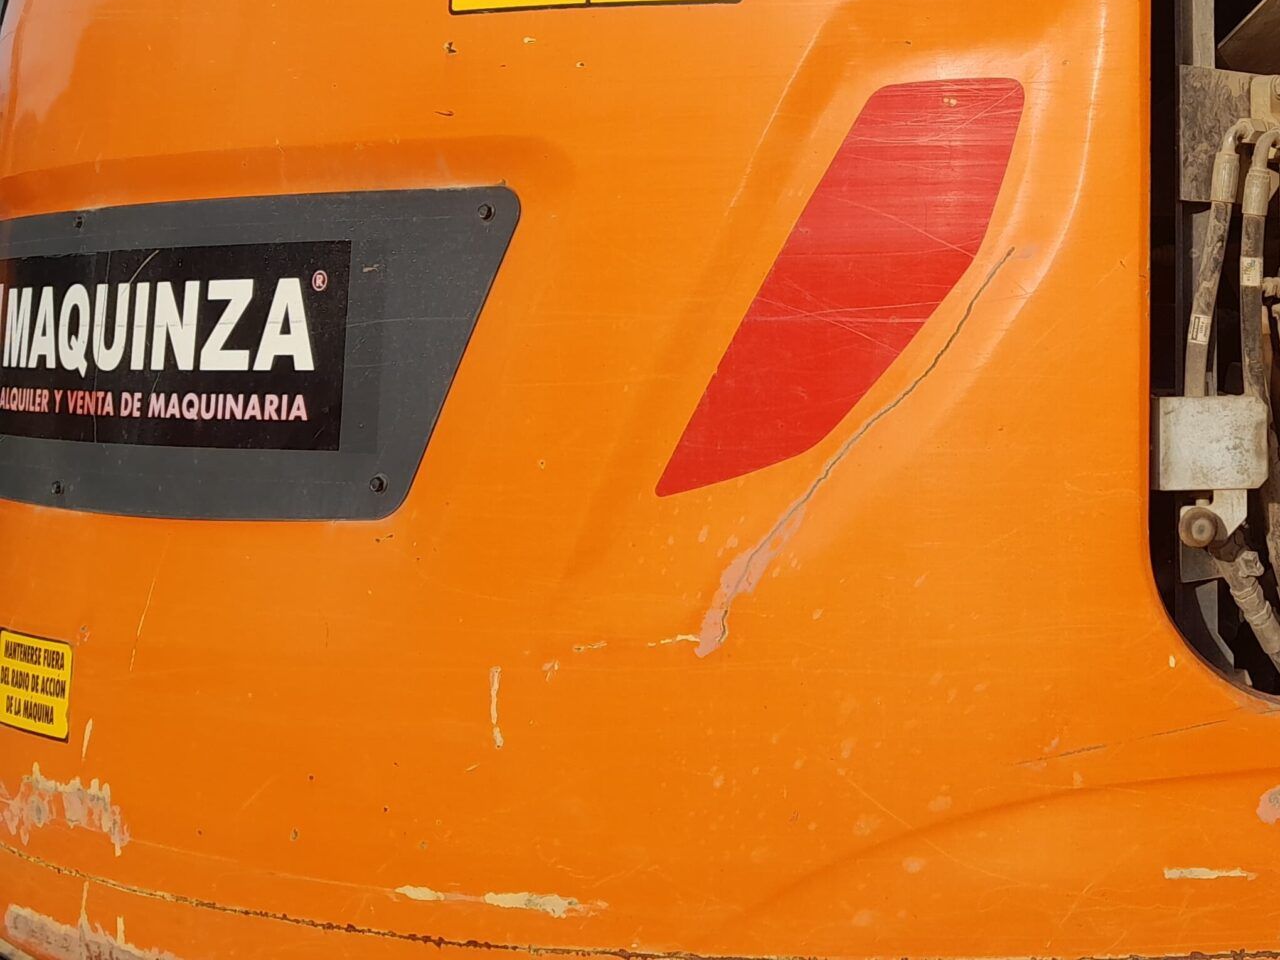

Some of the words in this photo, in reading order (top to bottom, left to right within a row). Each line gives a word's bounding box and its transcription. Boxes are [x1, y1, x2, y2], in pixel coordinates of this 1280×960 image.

[3, 278, 314, 378] MAQUINZA
[0, 387, 49, 413] ALQUILER
[54, 389, 63, 414] Y
[67, 390, 114, 417] VENTA
[120, 392, 142, 418] DE
[148, 393, 308, 421] MAQUINARIA
[4, 640, 42, 667] MANTENERSE
[43, 648, 65, 671] FUERA
[0, 665, 10, 686] DEL
[11, 668, 30, 692] RADIO
[31, 673, 39, 694] DE
[40, 674, 66, 699] ACCIÓN
[6, 694, 13, 714] DE
[14, 698, 21, 717] LA
[22, 696, 54, 725] MÁQUINA
